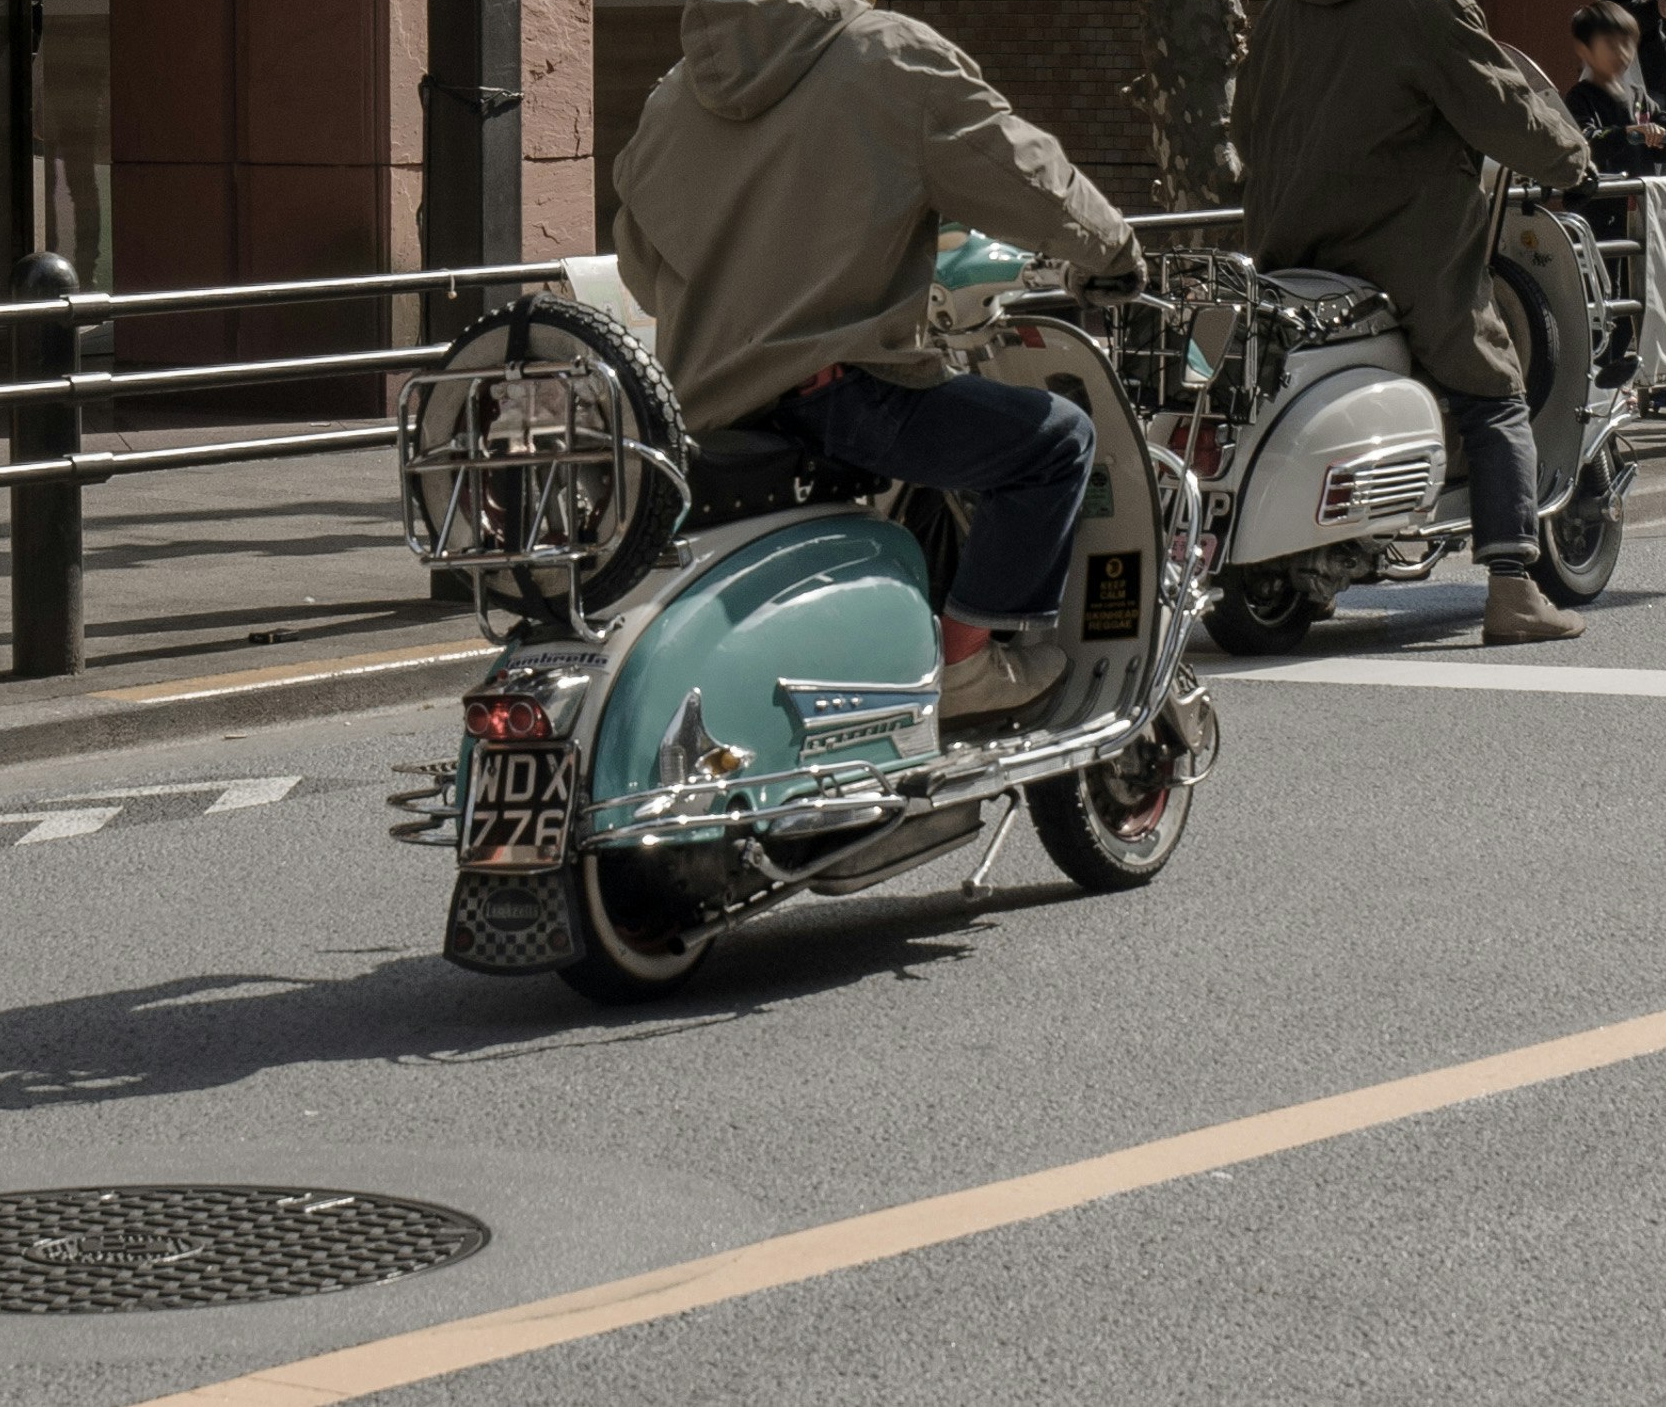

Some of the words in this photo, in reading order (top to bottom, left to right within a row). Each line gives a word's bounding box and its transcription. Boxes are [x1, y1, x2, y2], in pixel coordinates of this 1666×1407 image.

[1100, 579, 1126, 590] KEEP
[1100, 590, 1126, 600] CALM
[1085, 609, 1139, 620] SKINHEAD
[1087, 619, 1133, 632] REGGAE
[474, 753, 573, 803] WDX
